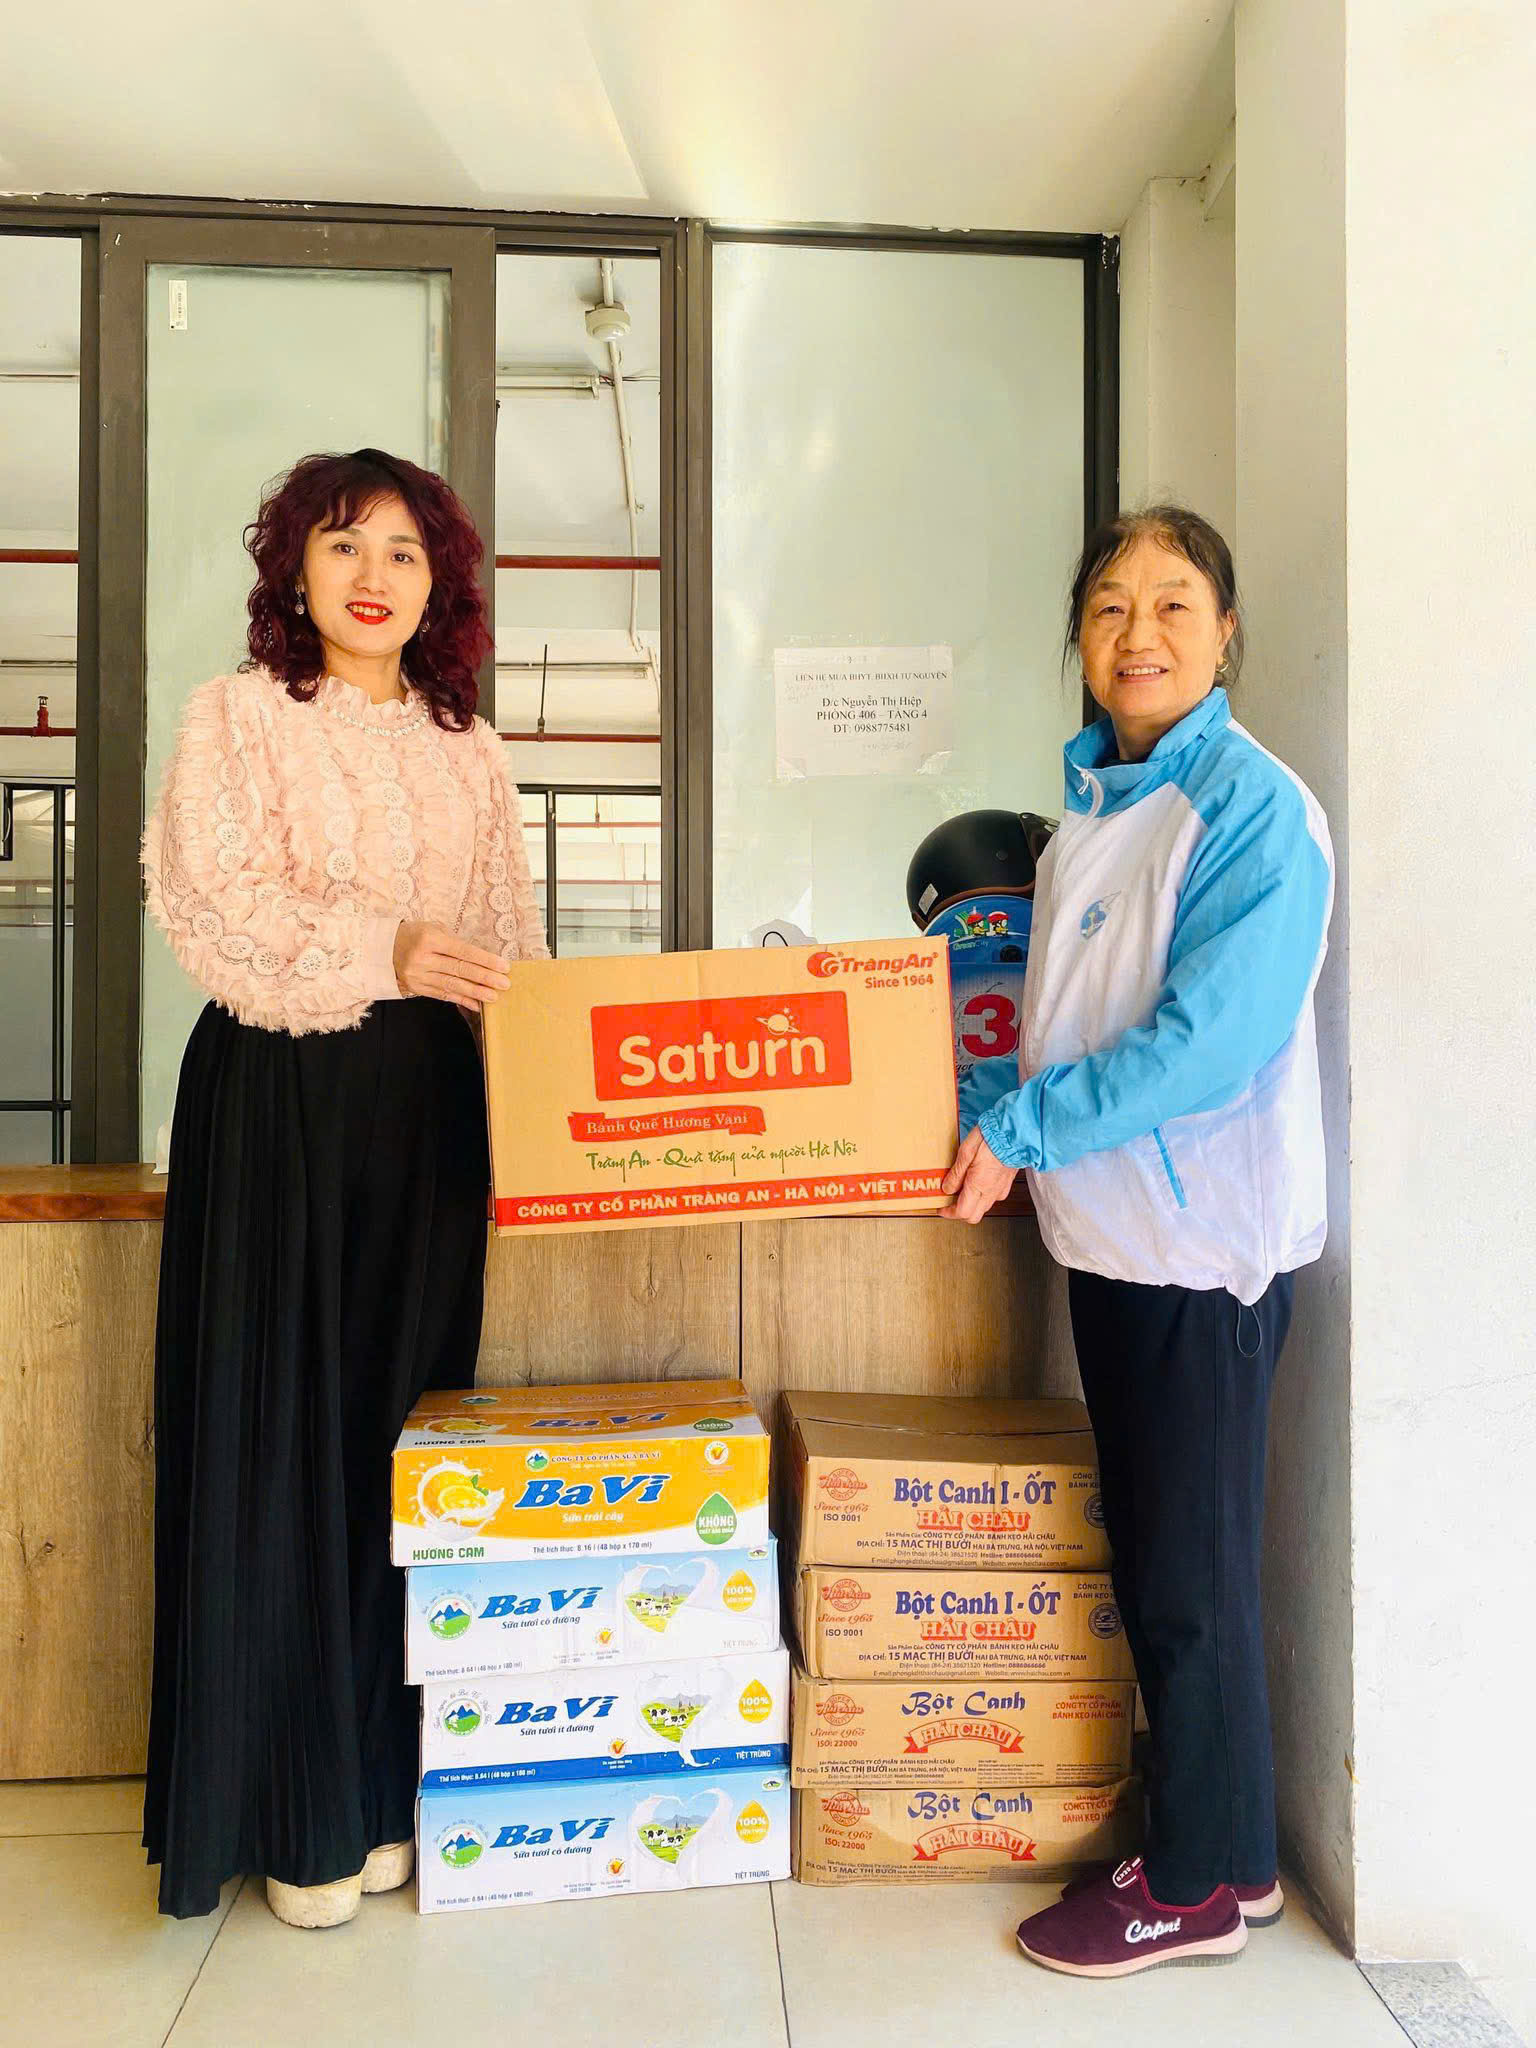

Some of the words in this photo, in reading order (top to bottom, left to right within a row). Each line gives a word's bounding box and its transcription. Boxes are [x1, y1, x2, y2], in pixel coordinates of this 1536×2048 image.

[842, 695, 877, 708] Nguyễn
[881, 697, 896, 707] Thị
[899, 696, 922, 708] Hiệp
[817, 708, 856, 720] PHÒNG
[859, 710, 876, 719] 406
[921, 710, 927, 718] 4
[854, 723, 911, 733] 0988775481
[864, 976, 899, 988] Since
[903, 974, 934, 986] 1964
[619, 1031, 826, 1086] Saturn
[586, 1121, 625, 1134] Bánh
[629, 1114, 658, 1131] Quế
[663, 1115, 712, 1130] Hương
[715, 1112, 748, 1125] Vani
[586, 1152, 626, 1183] Tràng
[628, 1150, 650, 1169] An
[663, 1148, 703, 1168] Quà
[708, 1150, 736, 1177] tặng
[741, 1145, 766, 1161] của
[770, 1147, 806, 1174] người
[808, 1140, 830, 1159] Hà
[833, 1138, 858, 1158] Nội
[517, 1202, 568, 1218] CÔNG
[572, 1202, 593, 1216] TY
[599, 1194, 623, 1213] CỔ
[629, 1190, 678, 1211] PHẦN
[683, 1187, 739, 1208] TRÀNG
[745, 1188, 770, 1202] AN
[785, 1182, 807, 1200] HÀ
[815, 1180, 845, 1201] NỘI
[859, 1177, 897, 1197] VIỆT
[902, 1176, 941, 1192] NAM
[514, 1478, 594, 1508] Ba
[894, 1478, 933, 1508] Bột
[938, 1479, 995, 1505] Canh
[1024, 1471, 1056, 1505] ỐT
[814, 1501, 843, 1511] Since
[698, 1513, 734, 1527] KHÔNG
[823, 1513, 839, 1521] ISO
[841, 1514, 861, 1522] 9001
[917, 1504, 963, 1530] HẢI
[966, 1506, 1031, 1532] CHÂU
[413, 1546, 455, 1560] HƯƠNG
[459, 1546, 485, 1559] CAM
[478, 1594, 542, 1619] Ba
[895, 1590, 935, 1620] Bột
[940, 1591, 998, 1615] Canh
[1028, 1581, 1061, 1615] ỐT
[502, 1620, 518, 1629] Sữa
[817, 1613, 846, 1622] Since
[843, 1629, 863, 1637] 9001
[920, 1615, 967, 1640] HẢI
[970, 1617, 1036, 1641] CHÂU
[925, 1642, 945, 1650] CÔNG
[990, 1642, 1010, 1650] BÁNH
[889, 1652, 900, 1660] 15
[903, 1652, 926, 1662] MẠC
[928, 1652, 945, 1662] THỊ
[948, 1649, 974, 1660] BƯỞI
[741, 1695, 769, 1705] 100%
[901, 1691, 954, 1716] Bột
[964, 1691, 1026, 1716] Canh
[494, 1701, 557, 1725] Ba
[1052, 1711, 1074, 1719] BÁNH
[520, 1727, 536, 1736] Sữa
[538, 1725, 556, 1735] tươi
[565, 1723, 595, 1734] đường
[811, 1727, 839, 1737] Since
[922, 1721, 959, 1743] HẢI
[959, 1722, 1012, 1744] CHÂU
[834, 1739, 858, 1747] 22000
[736, 1751, 749, 1760] TIỆT
[750, 1749, 771, 1759] TRÙNG
[907, 1791, 960, 1819] Bột
[971, 1792, 1033, 1820] Canh
[738, 1816, 766, 1827] 100%
[490, 1824, 553, 1848] Ba
[818, 1824, 845, 1836] Since
[824, 1837, 840, 1847] ISO:
[841, 1840, 866, 1850] 22000
[930, 1827, 967, 1853] HẢI
[968, 1829, 1023, 1854] CHÂU
[513, 1850, 530, 1860] Sữa
[532, 1848, 550, 1858] tươi
[564, 1845, 592, 1855] đường
